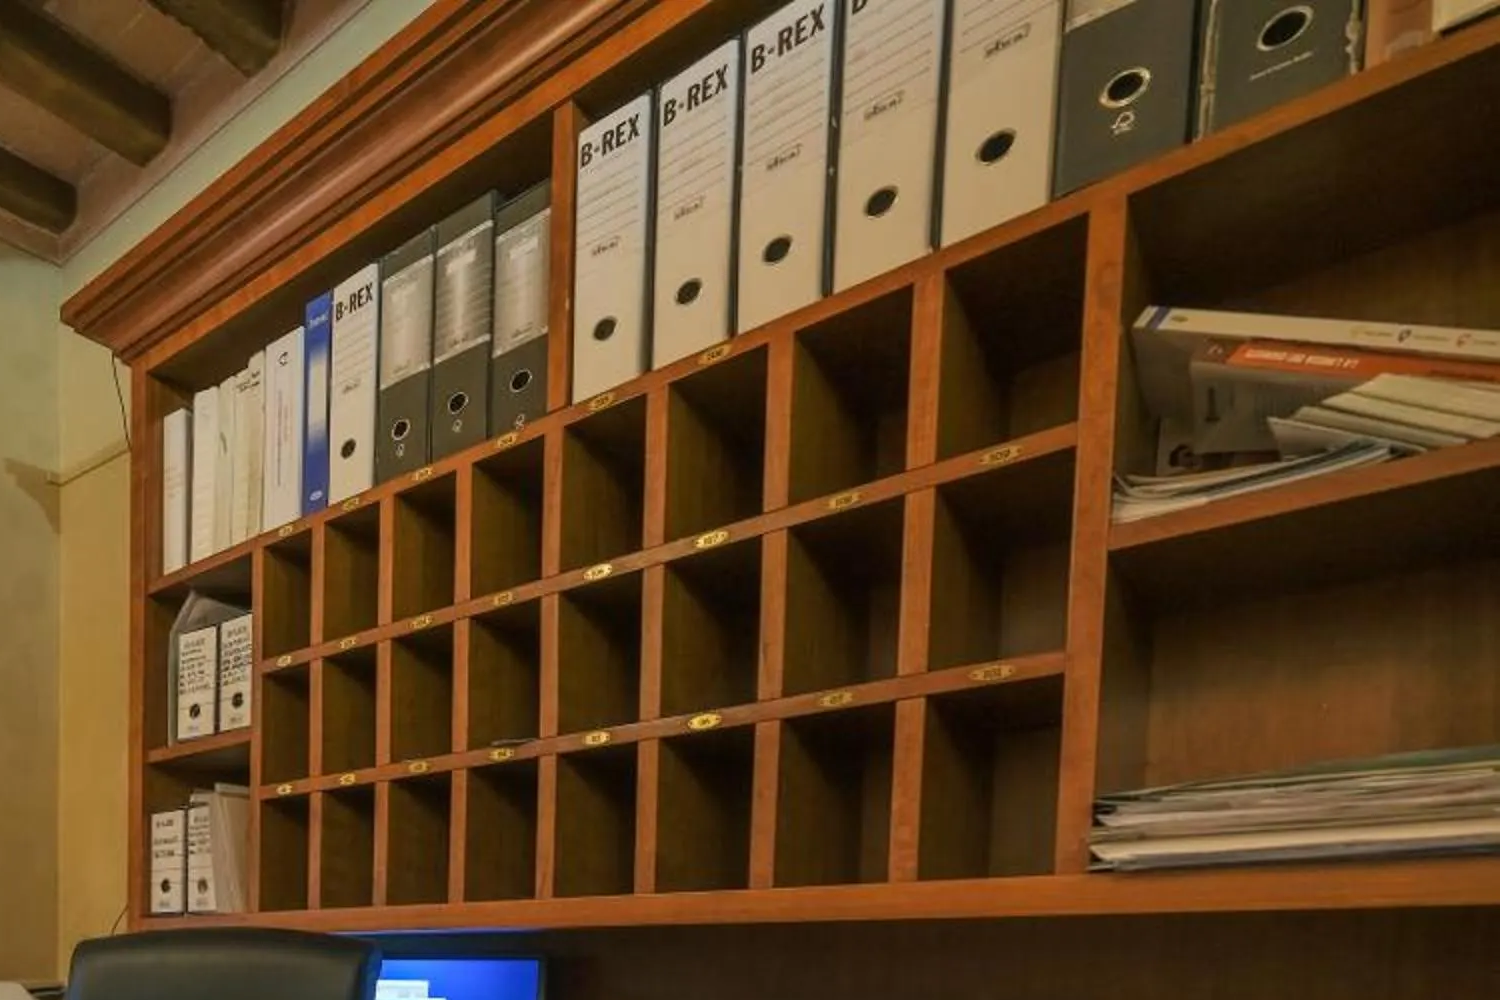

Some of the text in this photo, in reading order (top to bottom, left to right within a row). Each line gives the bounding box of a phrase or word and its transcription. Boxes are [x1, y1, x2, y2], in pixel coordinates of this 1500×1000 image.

[750, 3, 826, 75] B-REX
[662, 63, 729, 127] B-REX
[579, 112, 641, 170] B-REX
[335, 281, 375, 322] B-REX
